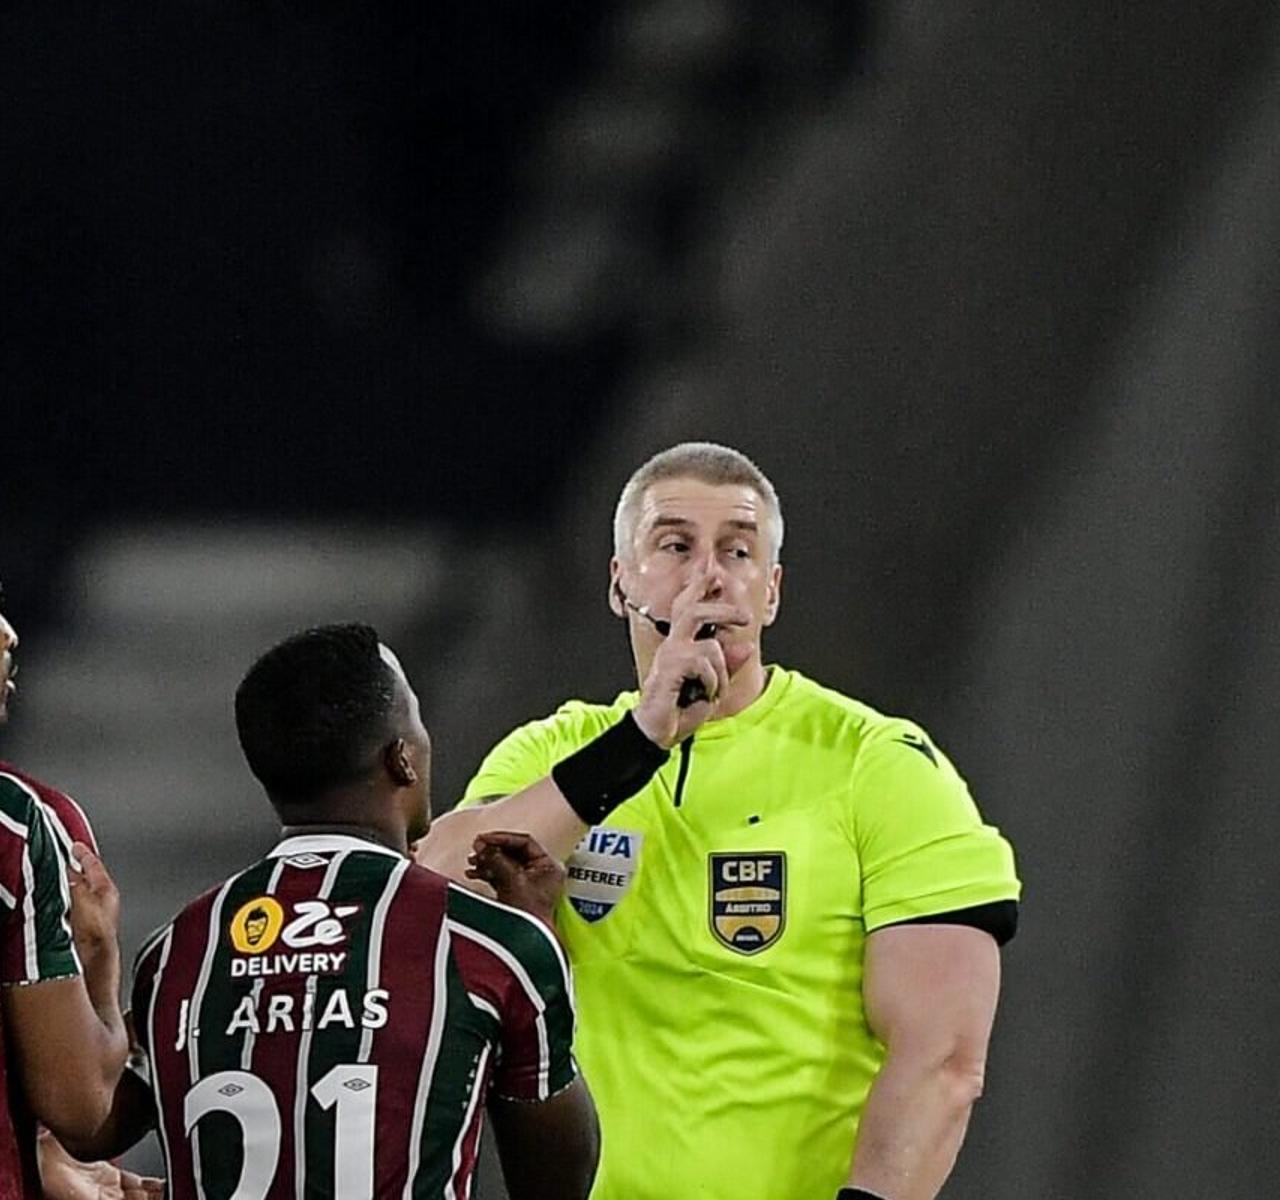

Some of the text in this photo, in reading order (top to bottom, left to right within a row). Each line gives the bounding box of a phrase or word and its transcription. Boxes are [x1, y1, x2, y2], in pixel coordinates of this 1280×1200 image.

[575, 832, 631, 859] IFA
[567, 867, 627, 888] REFEREE
[721, 860, 773, 882] CBF
[281, 900, 360, 949] Zé
[230, 952, 347, 978] DELIVERY
[225, 988, 390, 1036] ARIAS
